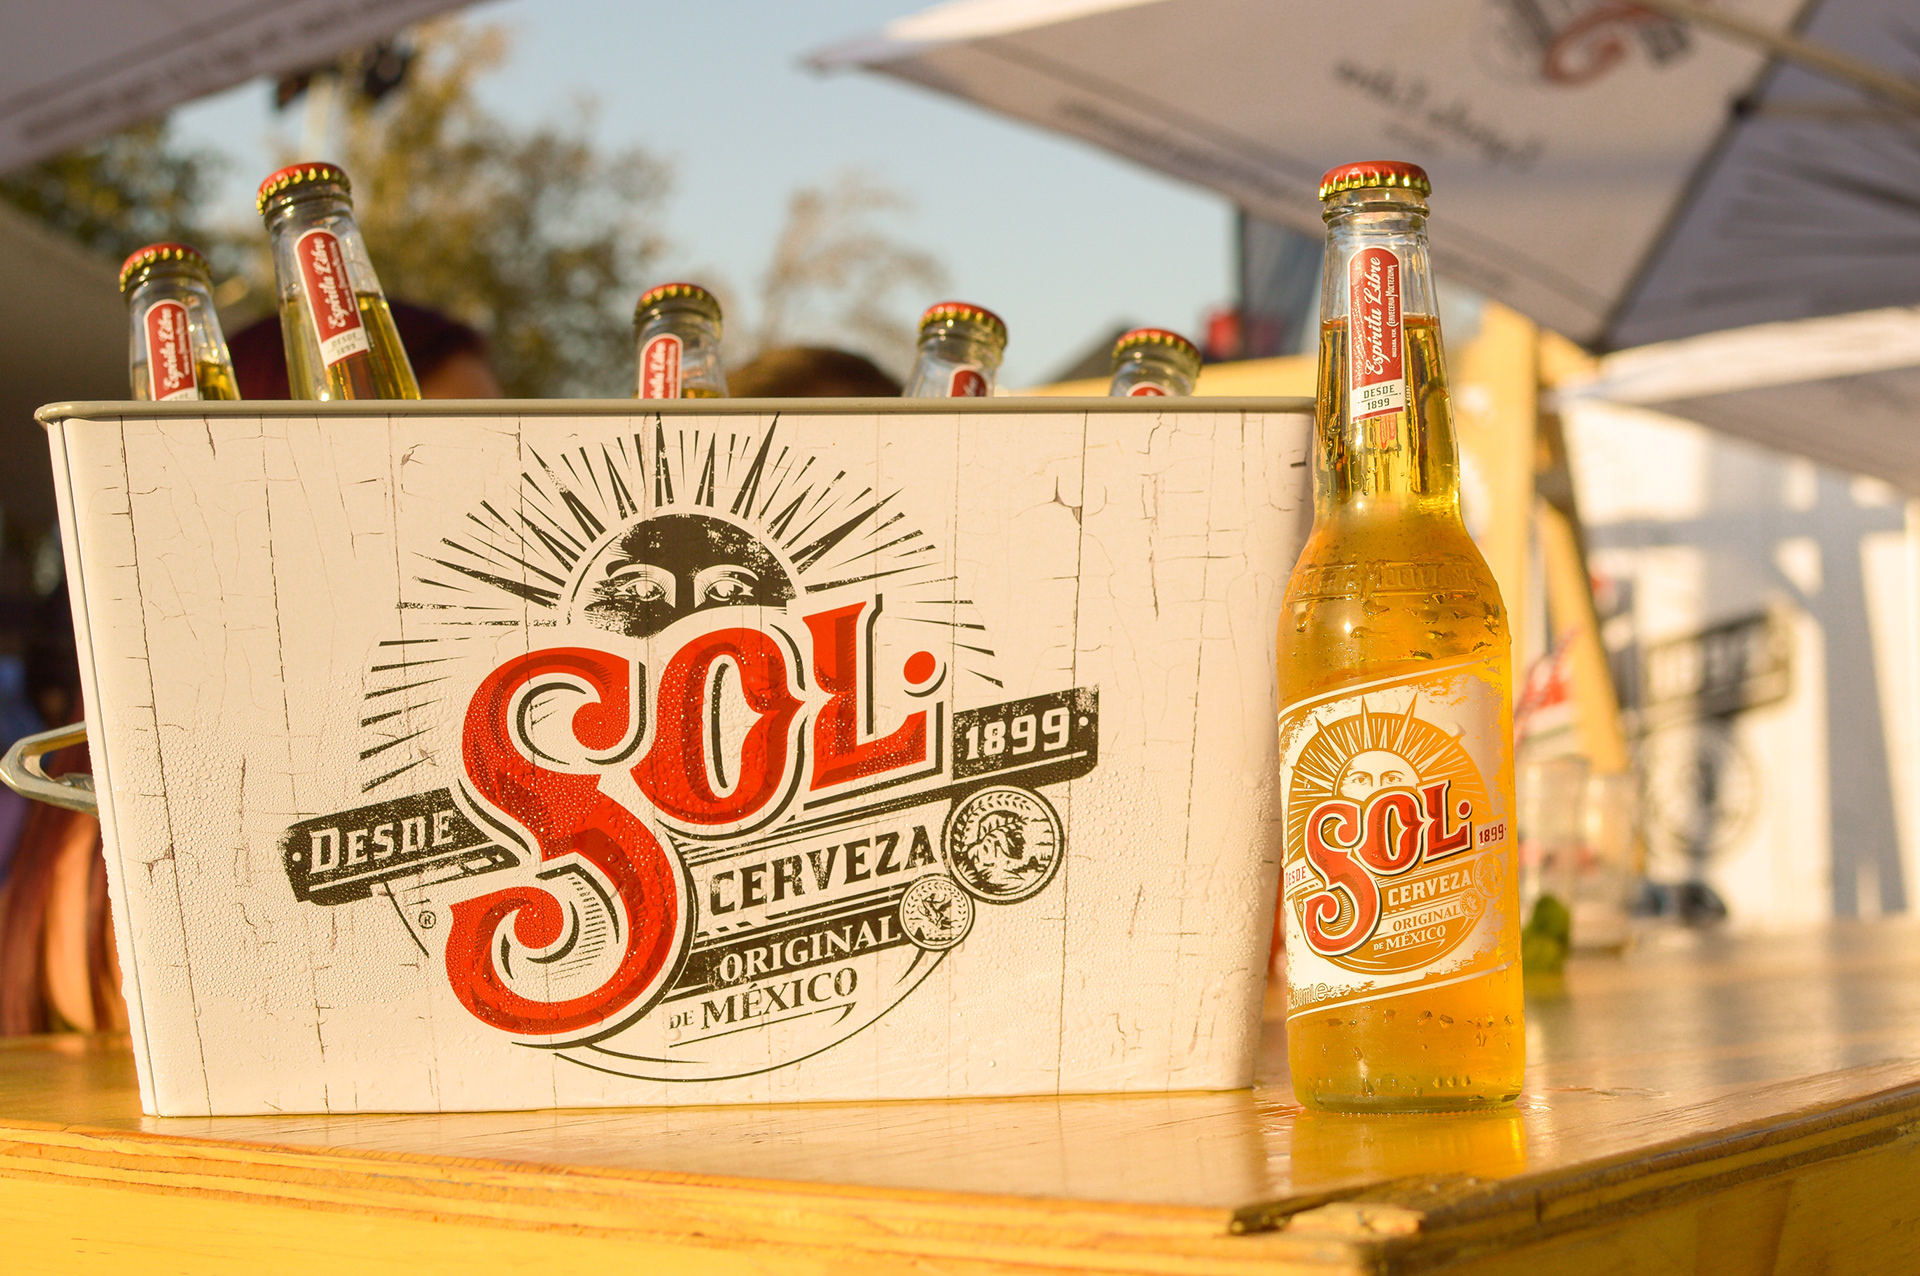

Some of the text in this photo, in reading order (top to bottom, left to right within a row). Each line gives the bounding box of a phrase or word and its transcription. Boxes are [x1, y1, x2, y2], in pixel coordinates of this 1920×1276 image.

[1364, 257, 1391, 376] Espíritu Libre
[1363, 384, 1395, 399] DESDE
[1367, 398, 1391, 411] 1899
[965, 706, 1070, 761] 1899
[309, 809, 455, 875] DESDE
[1479, 823, 1504, 844] 1899
[709, 825, 938, 916] CERVEZA
[1388, 869, 1474, 907] CERVEZA
[1373, 925, 1447, 951] DE MÉXICO
[1393, 904, 1460, 932] ORIGINAL
[719, 915, 902, 983] ORIGINAL
[668, 967, 858, 1030] DE MÉXICO
